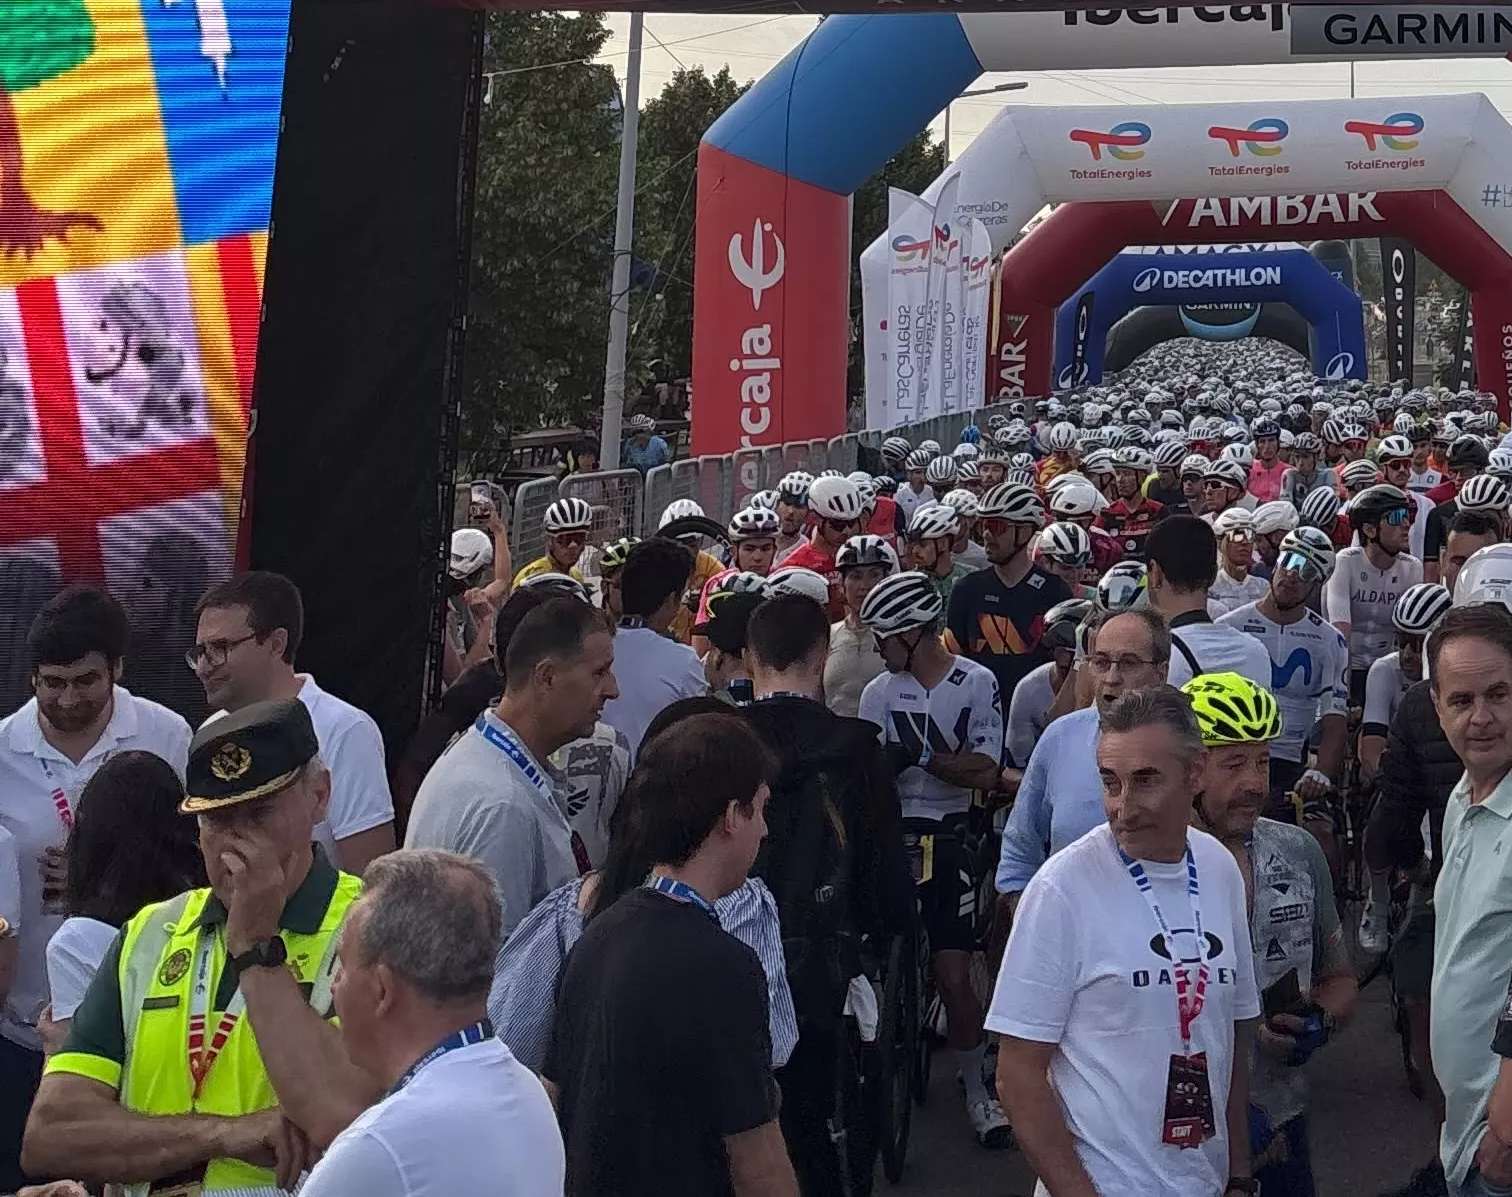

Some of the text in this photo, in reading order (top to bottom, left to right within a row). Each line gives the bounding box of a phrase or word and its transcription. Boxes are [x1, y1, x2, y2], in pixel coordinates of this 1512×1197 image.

[1208, 164, 1290, 177] TotalEnergies
[1345, 157, 1425, 171] TotalEnergies
[1069, 168, 1153, 180] TotalEnergies
[1187, 189, 1385, 227] AMBAR
[1163, 266, 1281, 289] DECATHLON
[1000, 338, 1028, 399] BAR
